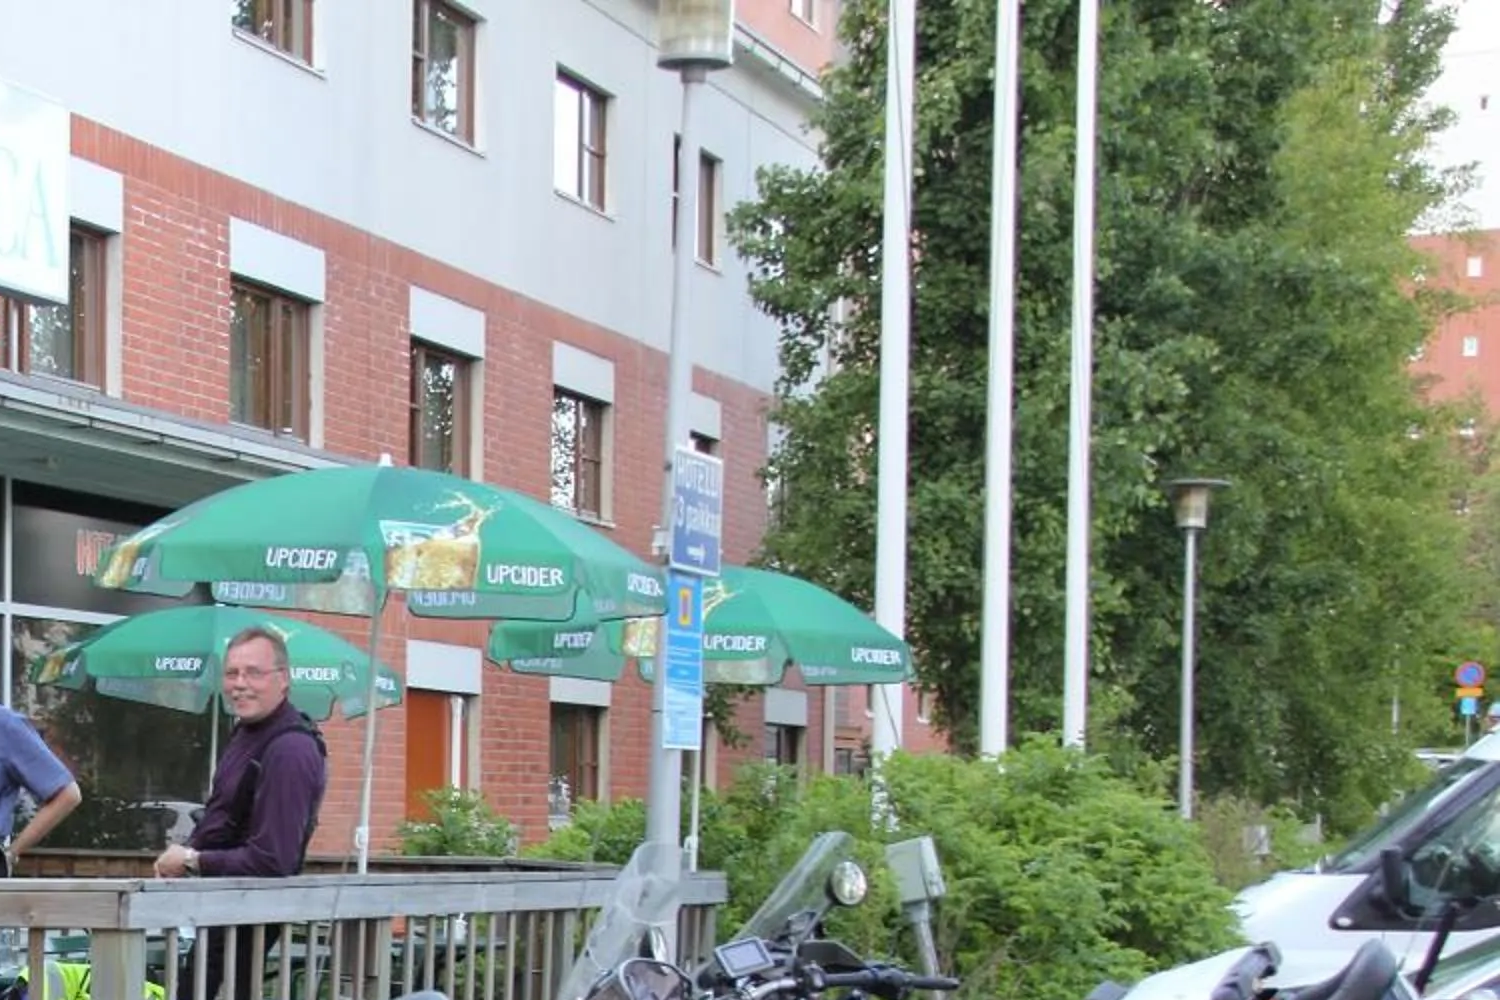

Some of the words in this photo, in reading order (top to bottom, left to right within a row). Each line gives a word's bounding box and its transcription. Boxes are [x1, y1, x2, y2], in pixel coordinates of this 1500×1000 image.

[266, 546, 337, 570] UPCIDER
[486, 563, 564, 587] UPCIDER
[703, 634, 767, 652] UPCIDER
[291, 667, 340, 681] UPCIDER
